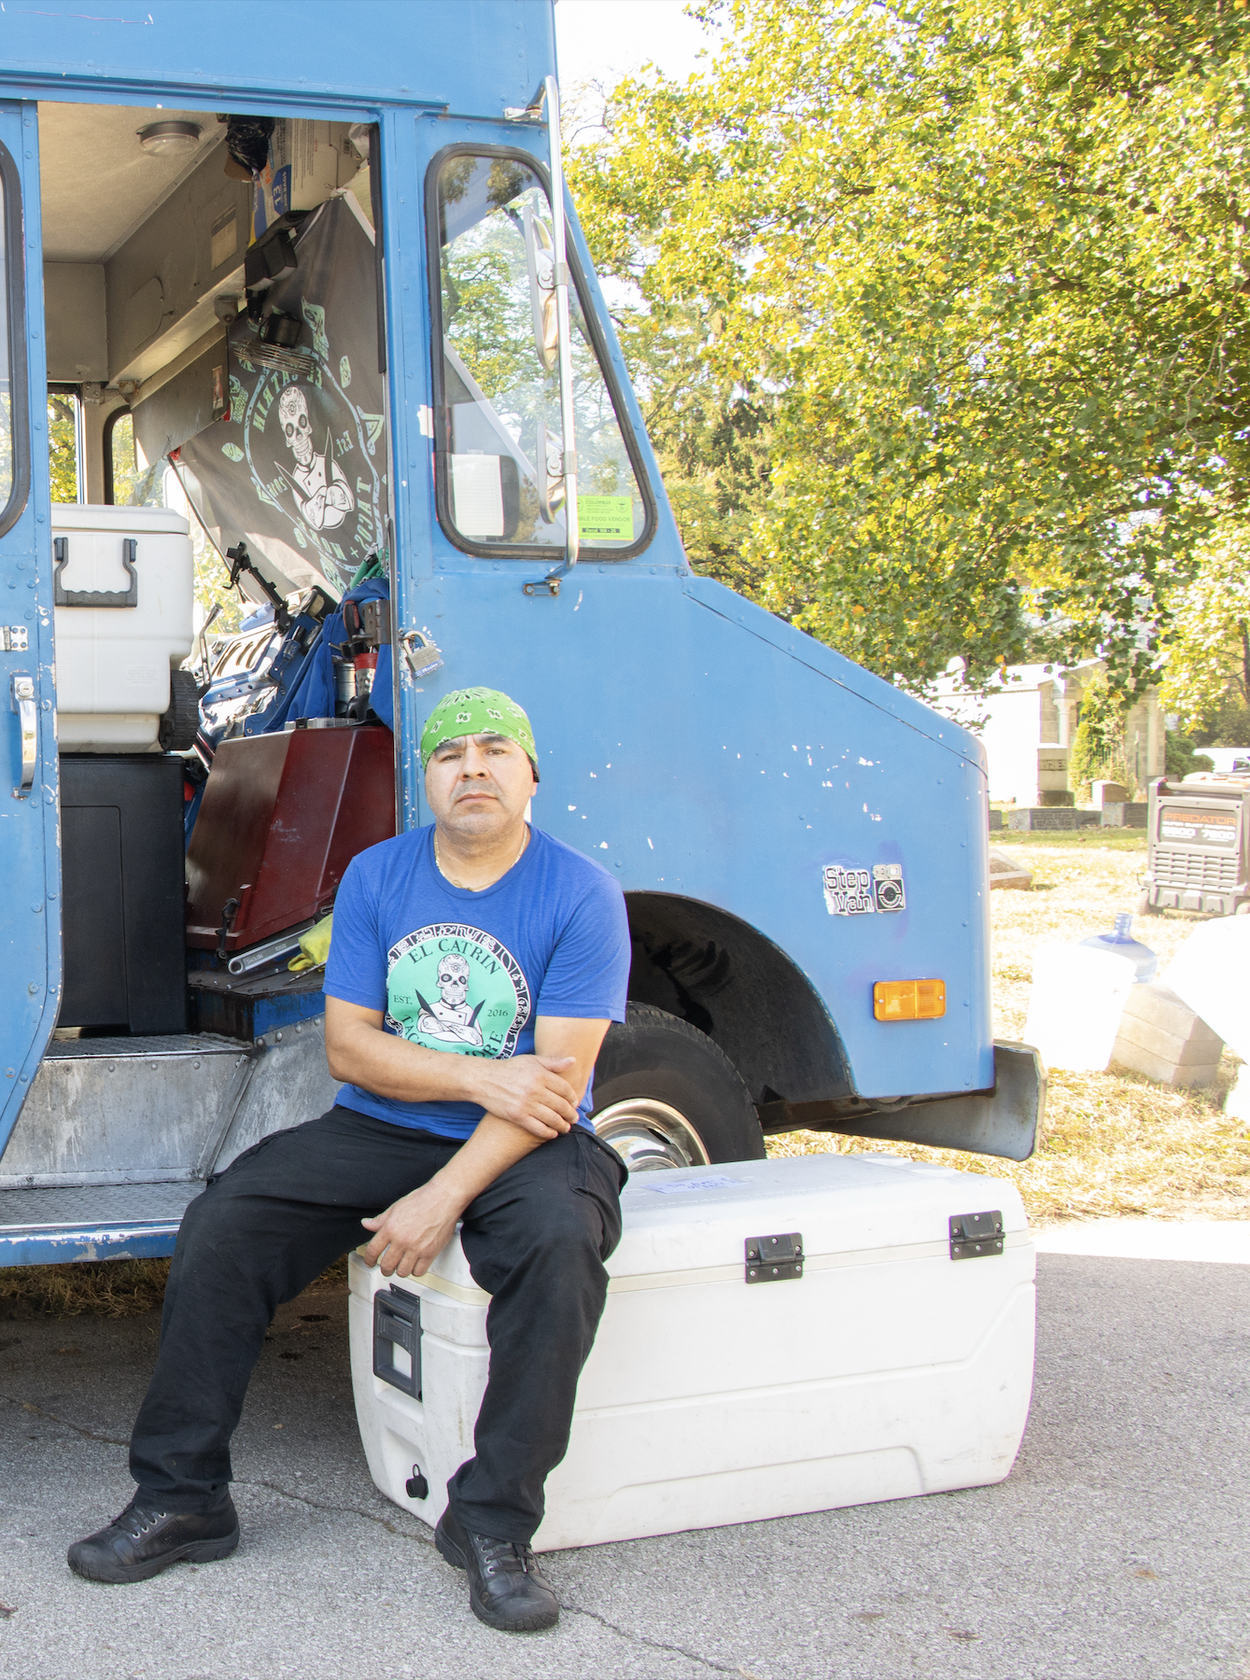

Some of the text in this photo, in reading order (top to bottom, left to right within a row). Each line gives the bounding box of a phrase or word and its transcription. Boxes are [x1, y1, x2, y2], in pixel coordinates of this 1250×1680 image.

[1163, 812, 1237, 826] PREDATOR
[825, 867, 870, 894] Step
[833, 891, 874, 914] Van
[408, 939, 501, 975] EL CATRIN
[393, 995, 412, 1005] EST.
[400, 1015, 437, 1051] TACO
